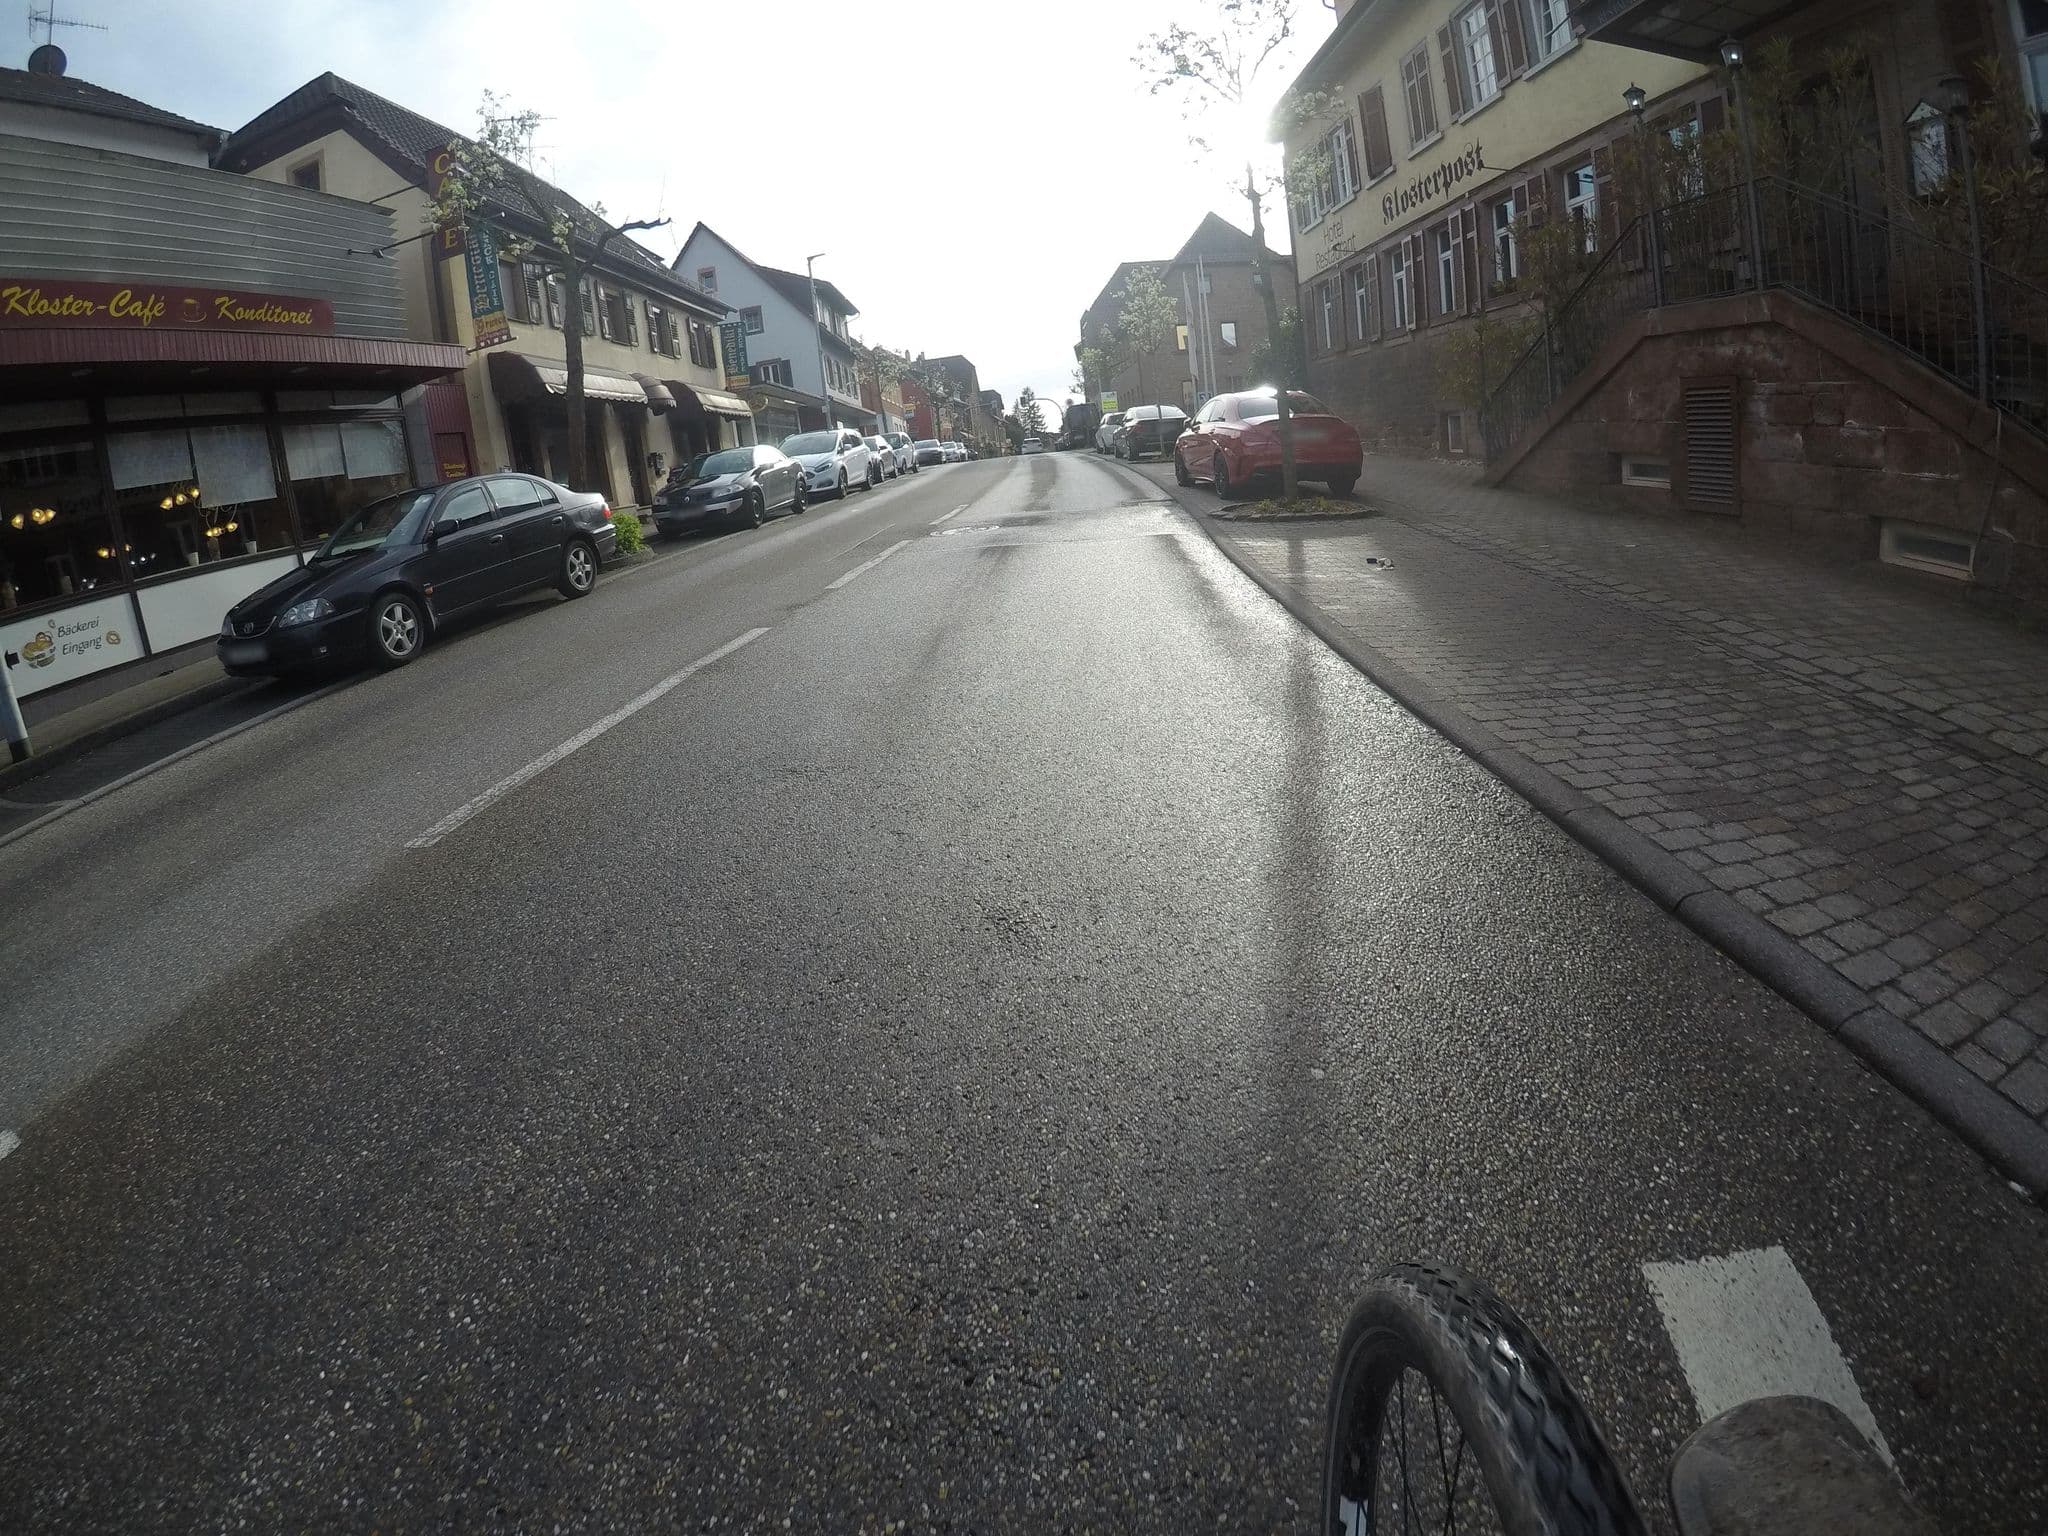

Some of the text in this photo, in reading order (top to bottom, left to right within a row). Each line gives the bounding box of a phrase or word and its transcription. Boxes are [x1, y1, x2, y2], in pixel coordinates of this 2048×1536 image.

[1382, 136, 1484, 226] Klosterpost
[1322, 216, 1344, 246] Hotel
[1315, 232, 1357, 272] Restaurant
[2, 286, 313, 326] Kloster-Café Konditorei
[57, 616, 100, 638] Bäckerei
[62, 637, 102, 655] Eingang
